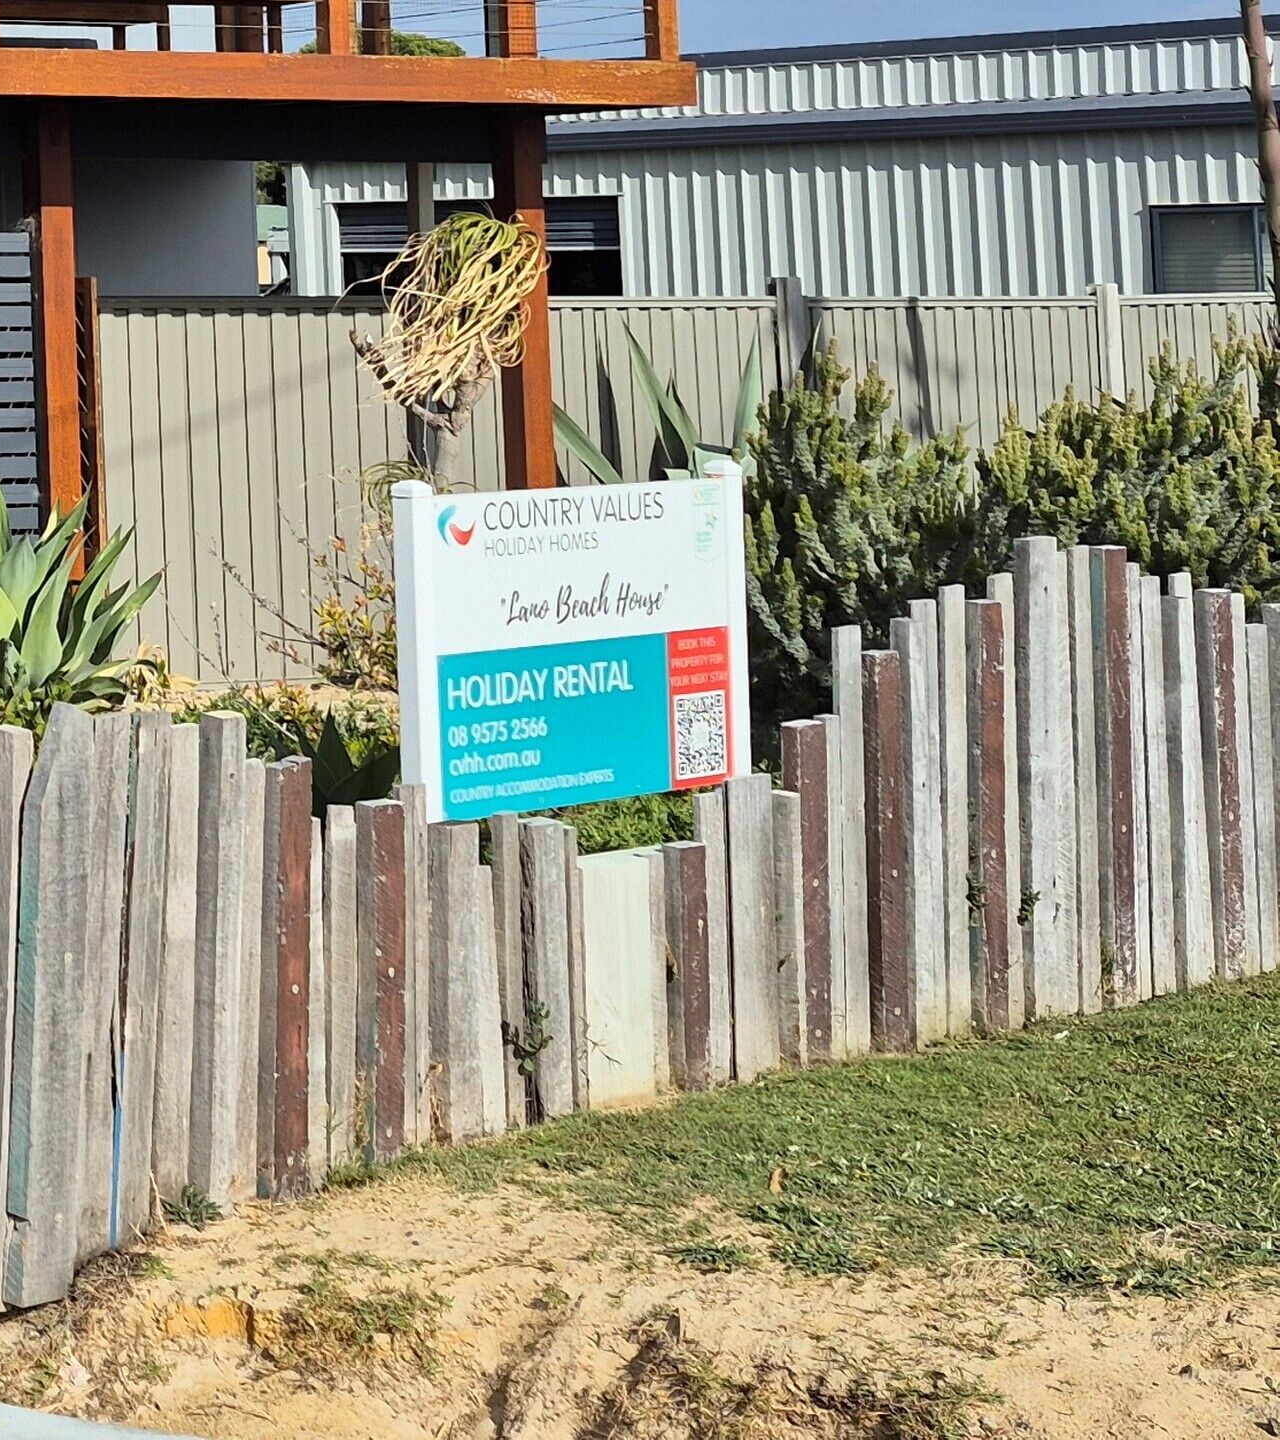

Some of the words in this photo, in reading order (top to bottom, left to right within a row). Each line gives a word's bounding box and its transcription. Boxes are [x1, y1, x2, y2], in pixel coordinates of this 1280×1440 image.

[483, 496, 585, 531] COUNTRY
[590, 491, 664, 524] VALUES
[484, 534, 546, 558] HOLIDAY
[549, 530, 599, 553] HOMES
[556, 572, 611, 625] Beach
[671, 654, 709, 669] PROPERTY
[447, 667, 549, 711] HOLIDAY
[553, 659, 634, 699] RENTAL
[447, 724, 468, 748] 08
[470, 719, 508, 744] 9575
[511, 715, 548, 741] 2566
[449, 748, 541, 777] cvhh.com.au
[450, 785, 495, 804] COUNTRY
